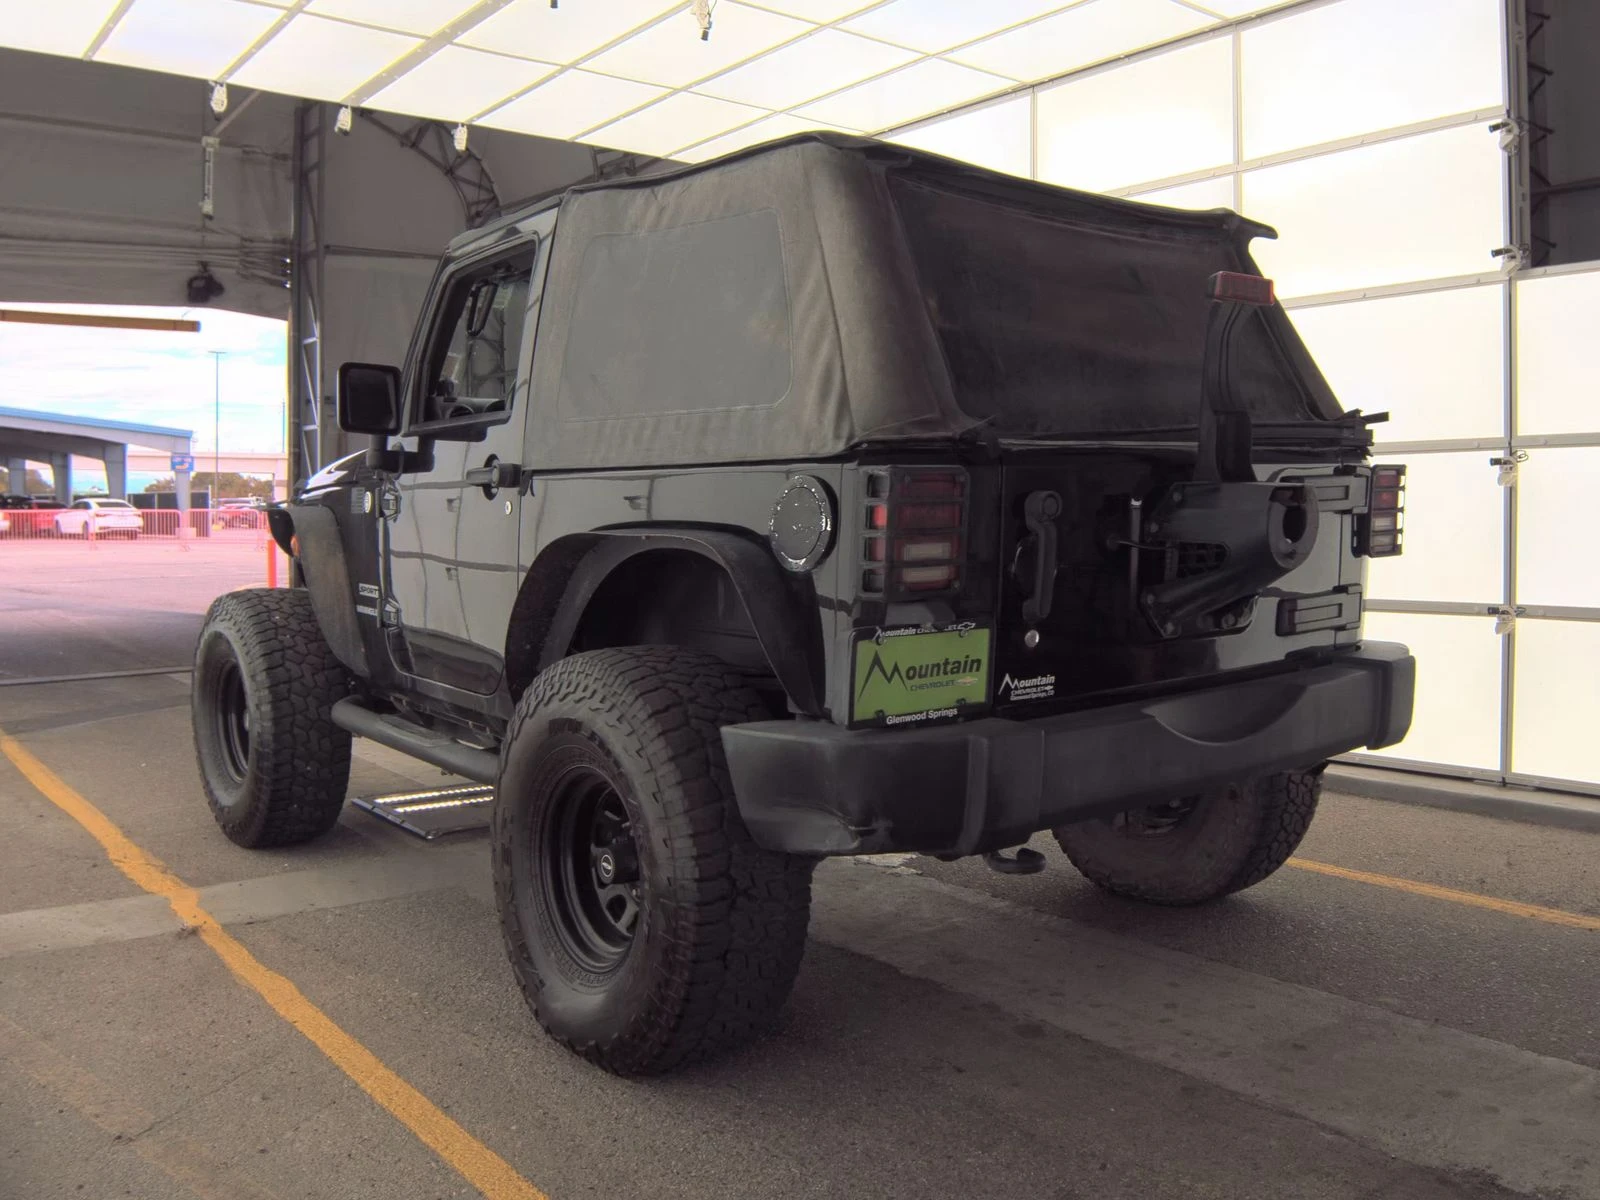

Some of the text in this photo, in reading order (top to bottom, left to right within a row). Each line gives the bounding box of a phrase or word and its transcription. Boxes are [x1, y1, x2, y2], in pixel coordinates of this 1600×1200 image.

[857, 649, 982, 703] Mountain
[910, 679, 955, 692] CHEVROLET
[998, 673, 1055, 695] Mountain
[886, 708, 958, 725] Glenwood Springs
